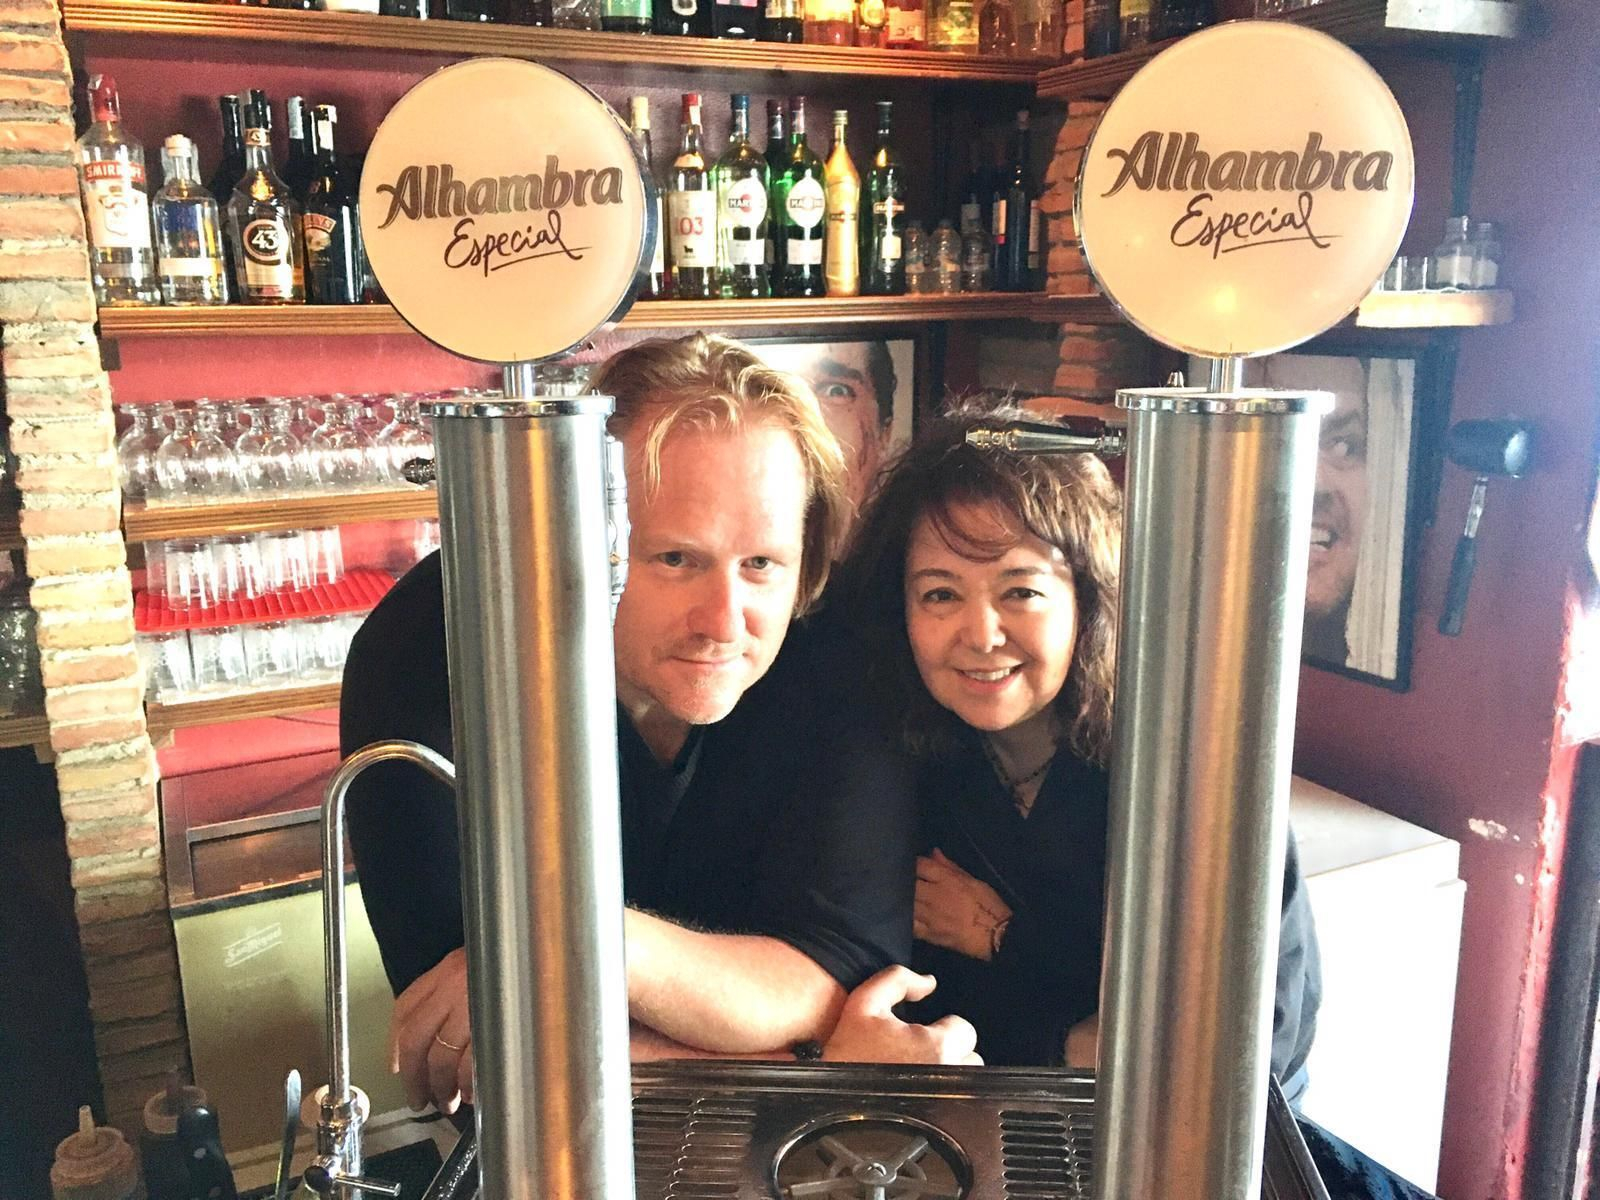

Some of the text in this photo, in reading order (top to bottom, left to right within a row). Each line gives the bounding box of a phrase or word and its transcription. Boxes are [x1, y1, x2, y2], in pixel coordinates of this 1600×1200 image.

[86, 163, 143, 178] SMIRFF
[376, 155, 623, 228] Alhambra
[1101, 130, 1393, 198] Alhambra
[252, 230, 278, 249] 43
[444, 210, 584, 277] Especial
[1170, 191, 1332, 259] Especial
